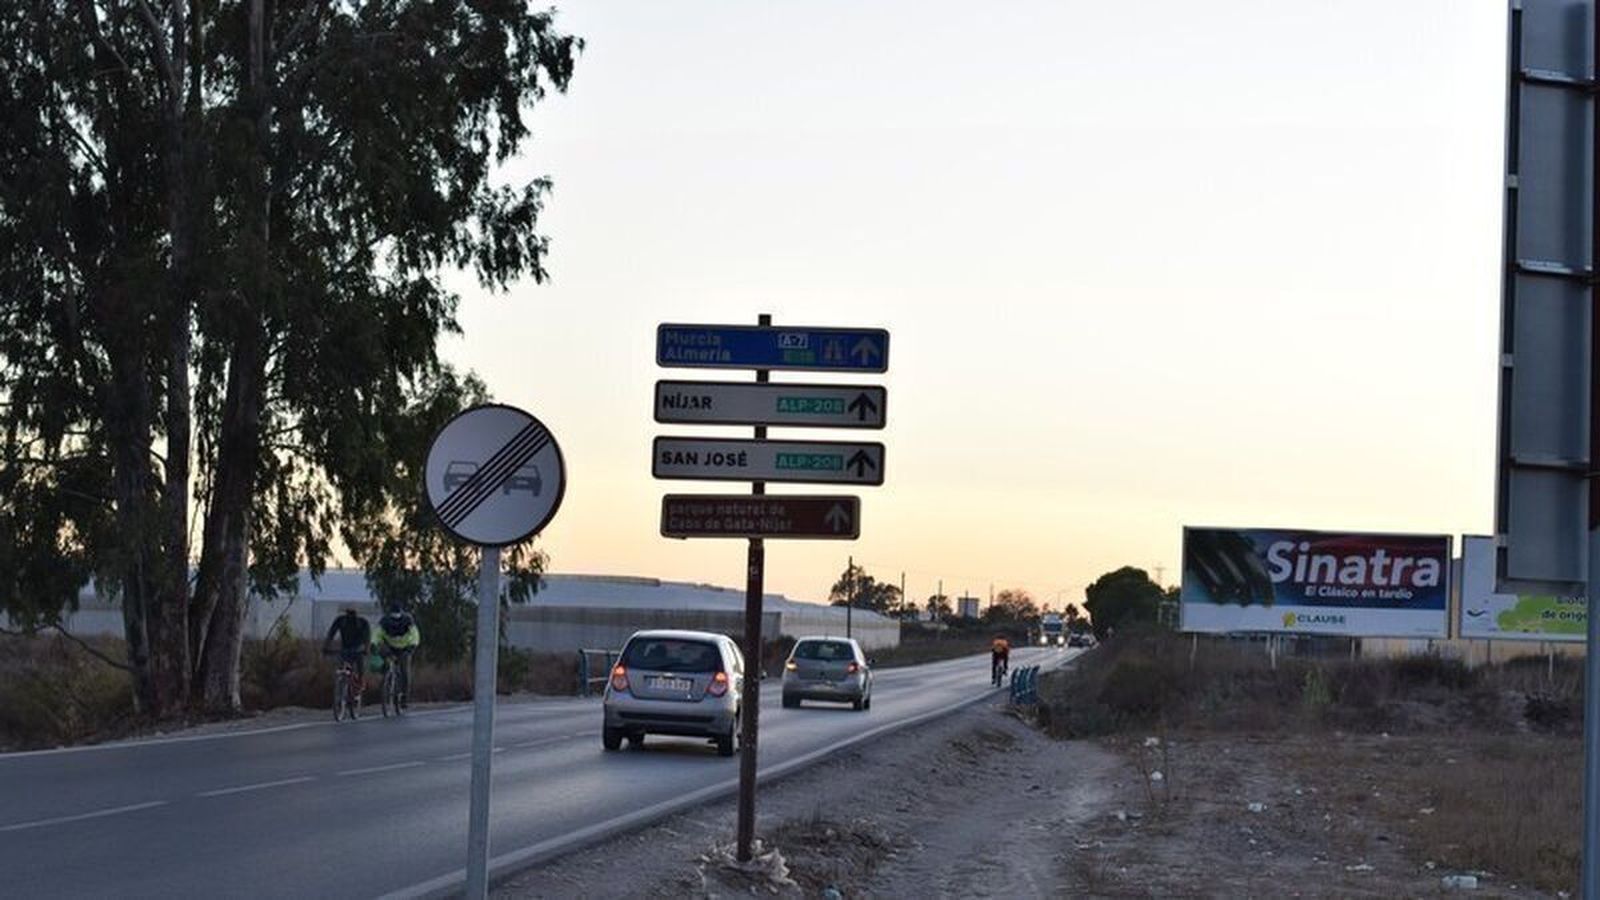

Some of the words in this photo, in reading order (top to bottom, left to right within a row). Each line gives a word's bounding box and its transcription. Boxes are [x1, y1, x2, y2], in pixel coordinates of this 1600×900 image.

[665, 331, 721, 346] Murcia
[662, 451, 698, 465] SAN
[704, 450, 748, 467] JOSÉ
[1267, 541, 1440, 587] Sinatra
[1305, 585, 1317, 597] El
[1318, 585, 1358, 598] Clásico
[1361, 589, 1376, 599] en
[1297, 614, 1345, 624] CLAUSE
[1542, 608, 1555, 620] de
